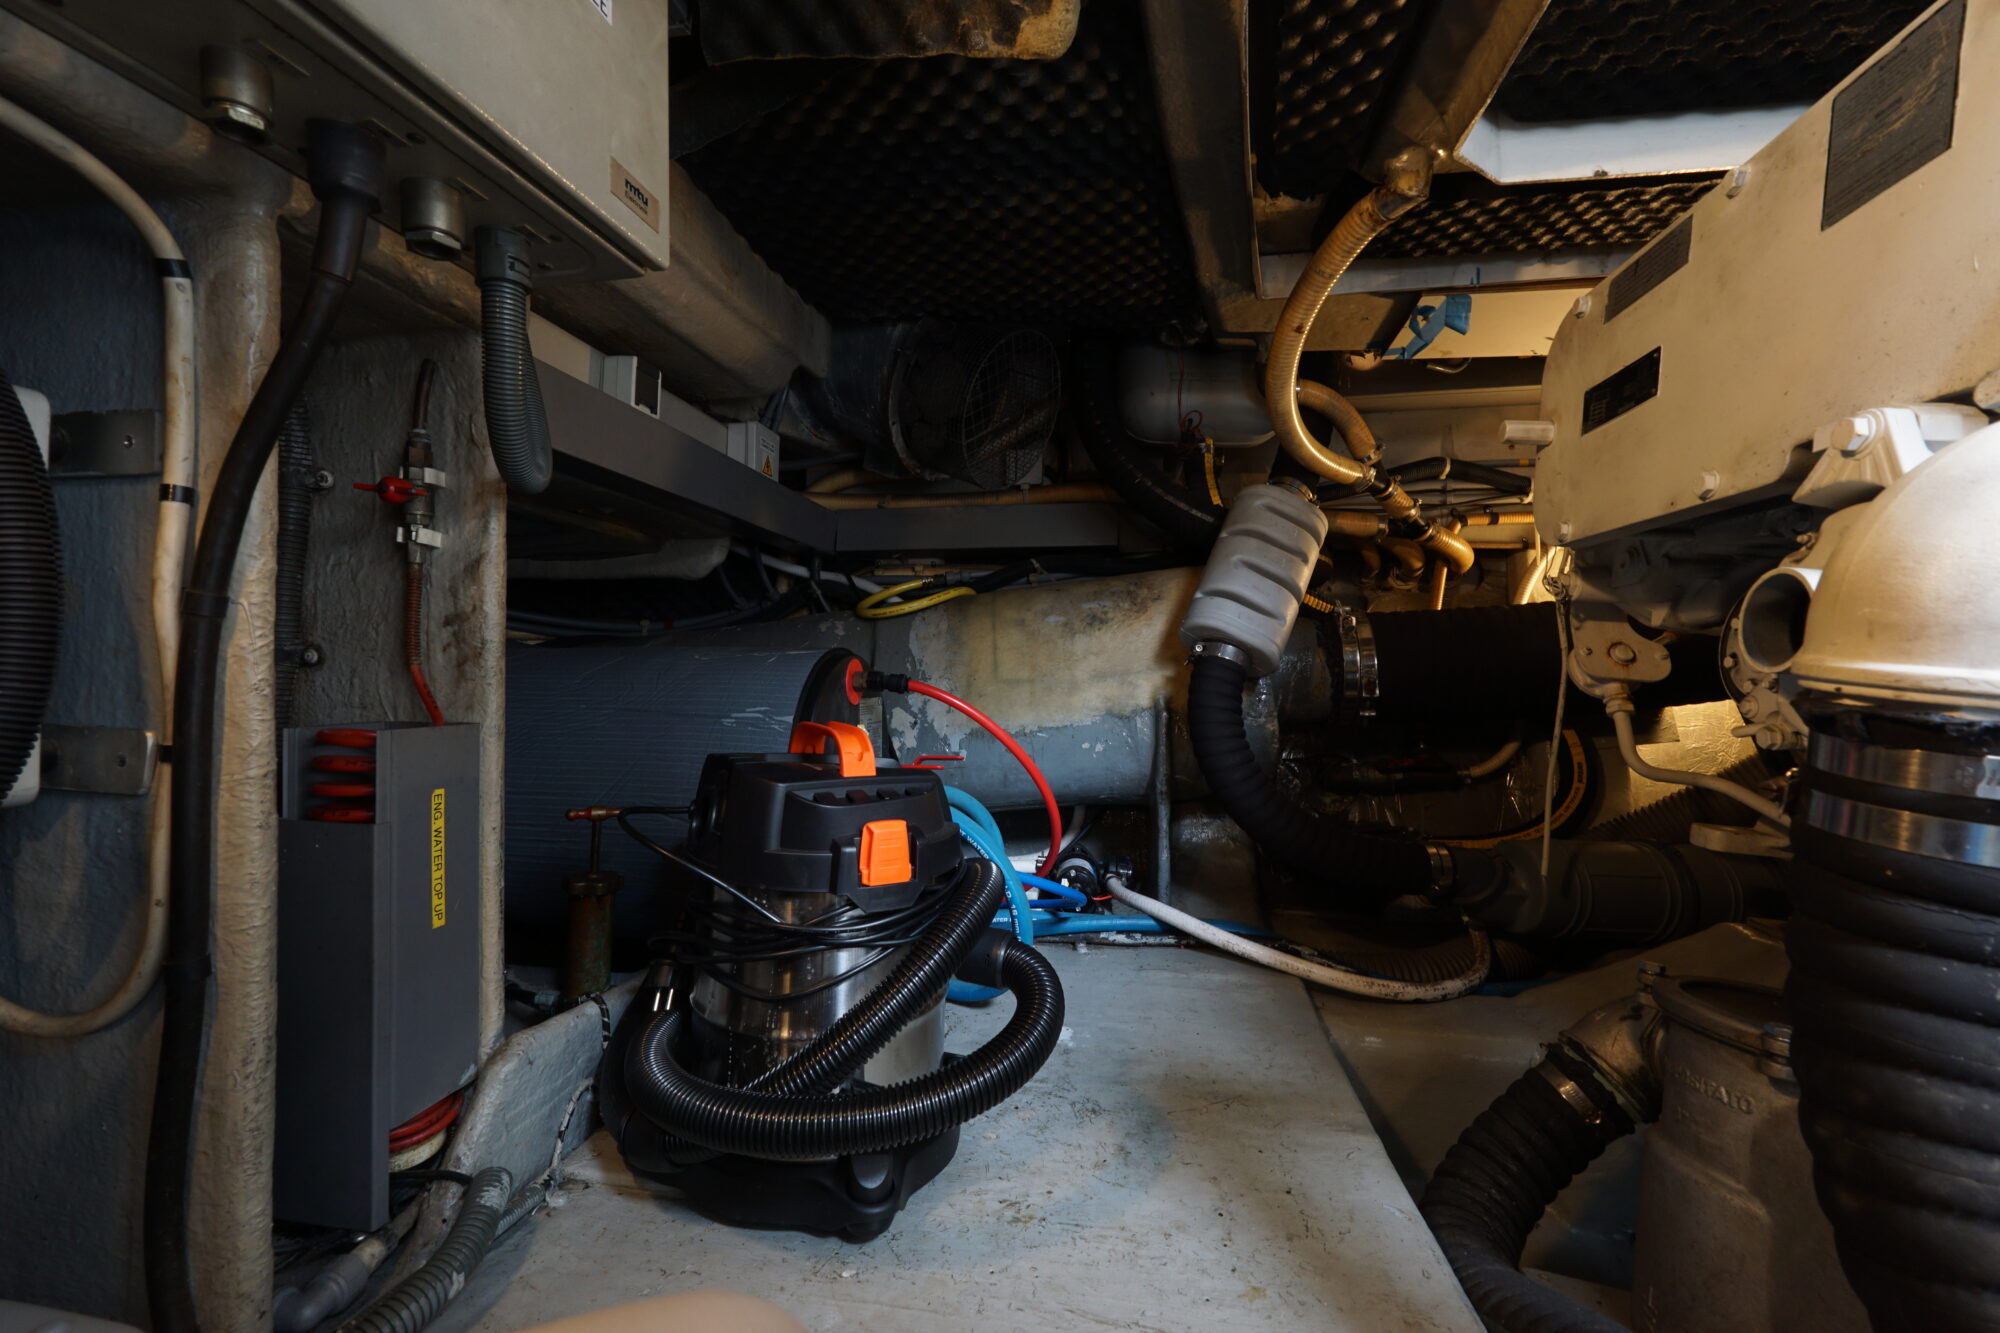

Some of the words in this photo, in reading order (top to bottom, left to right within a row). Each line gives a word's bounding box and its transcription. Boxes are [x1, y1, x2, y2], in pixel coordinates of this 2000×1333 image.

[624, 178, 649, 207] mtu
[433, 793, 443, 825] ENG.
[433, 826, 443, 872] WATER
[967, 835, 990, 860] WATER
[433, 873, 443, 900] TOP
[433, 903, 444, 921] UP
